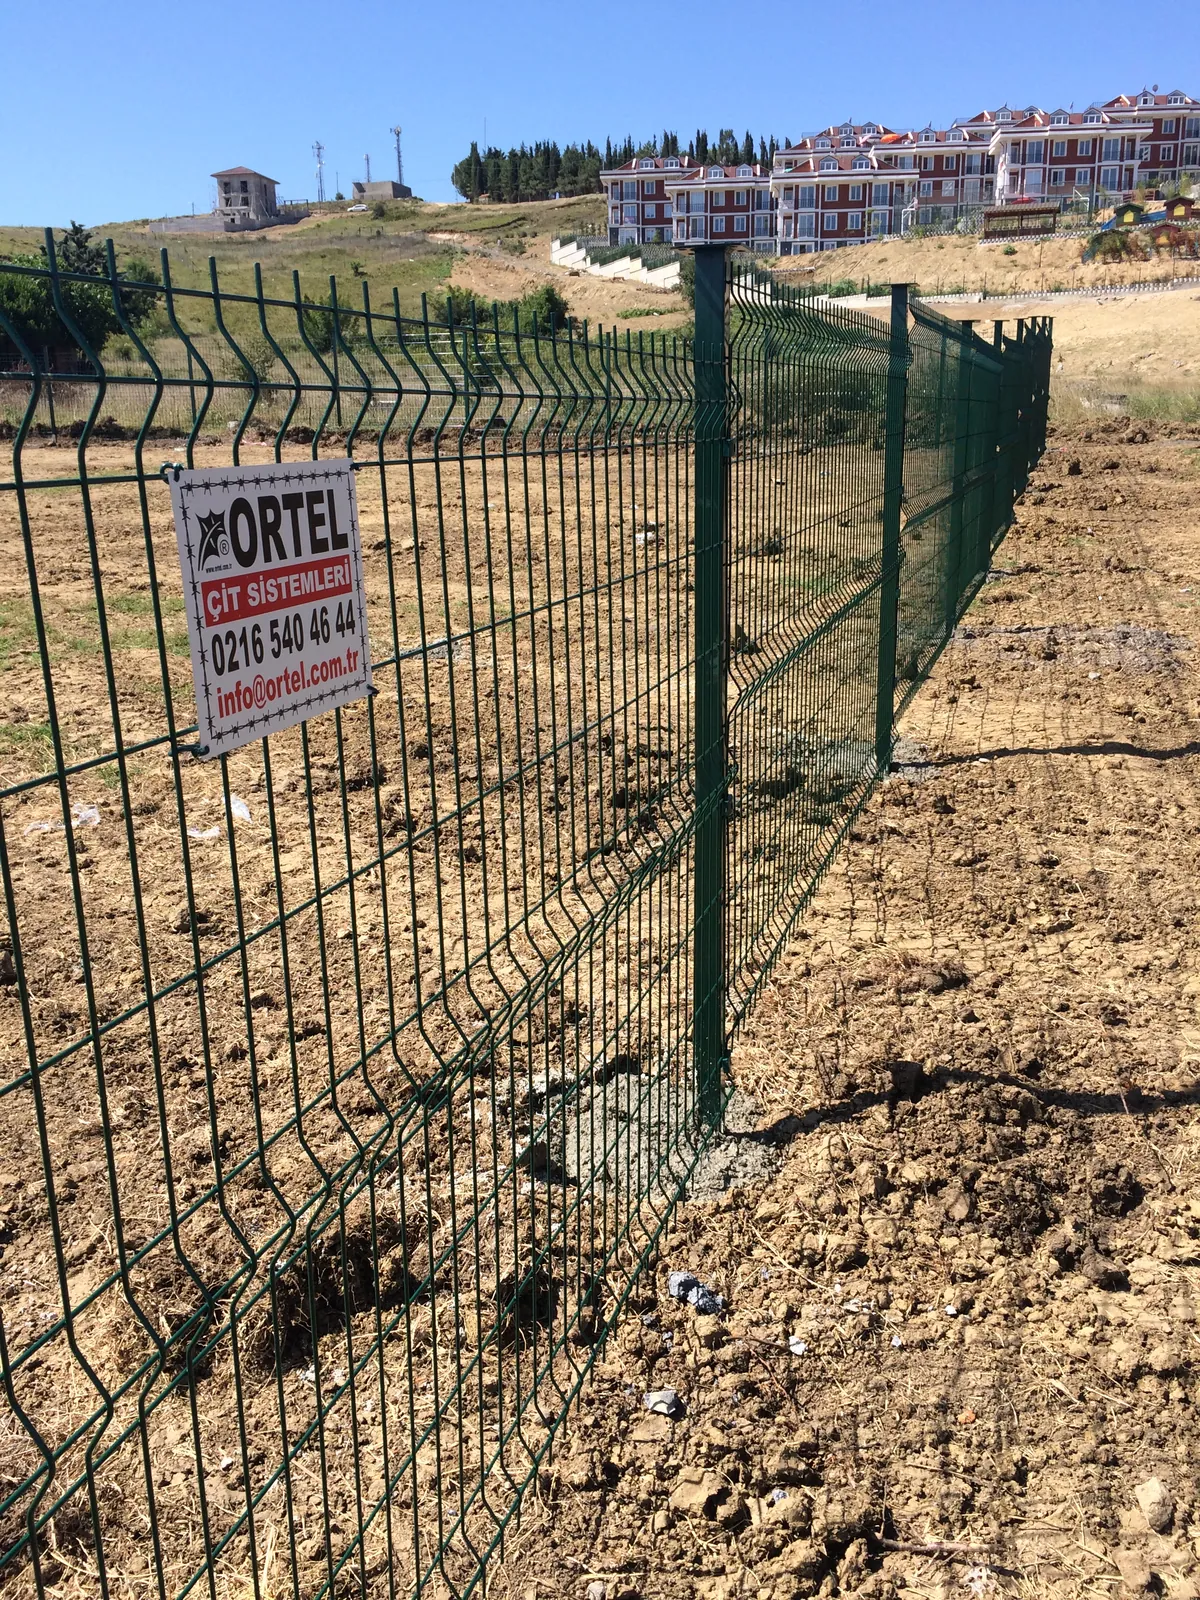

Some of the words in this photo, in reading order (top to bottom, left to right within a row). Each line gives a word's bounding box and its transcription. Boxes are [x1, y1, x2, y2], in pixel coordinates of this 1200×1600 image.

[229, 489, 349, 568] ORTEL
[206, 582, 241, 621] ÇİT
[247, 558, 351, 607] SİSTEMLERİ
[211, 623, 264, 676] 0216
[270, 612, 304, 659] 540
[310, 606, 330, 646] 46
[335, 600, 356, 638] 44
[216, 647, 359, 719] info@ortel.com.tr
